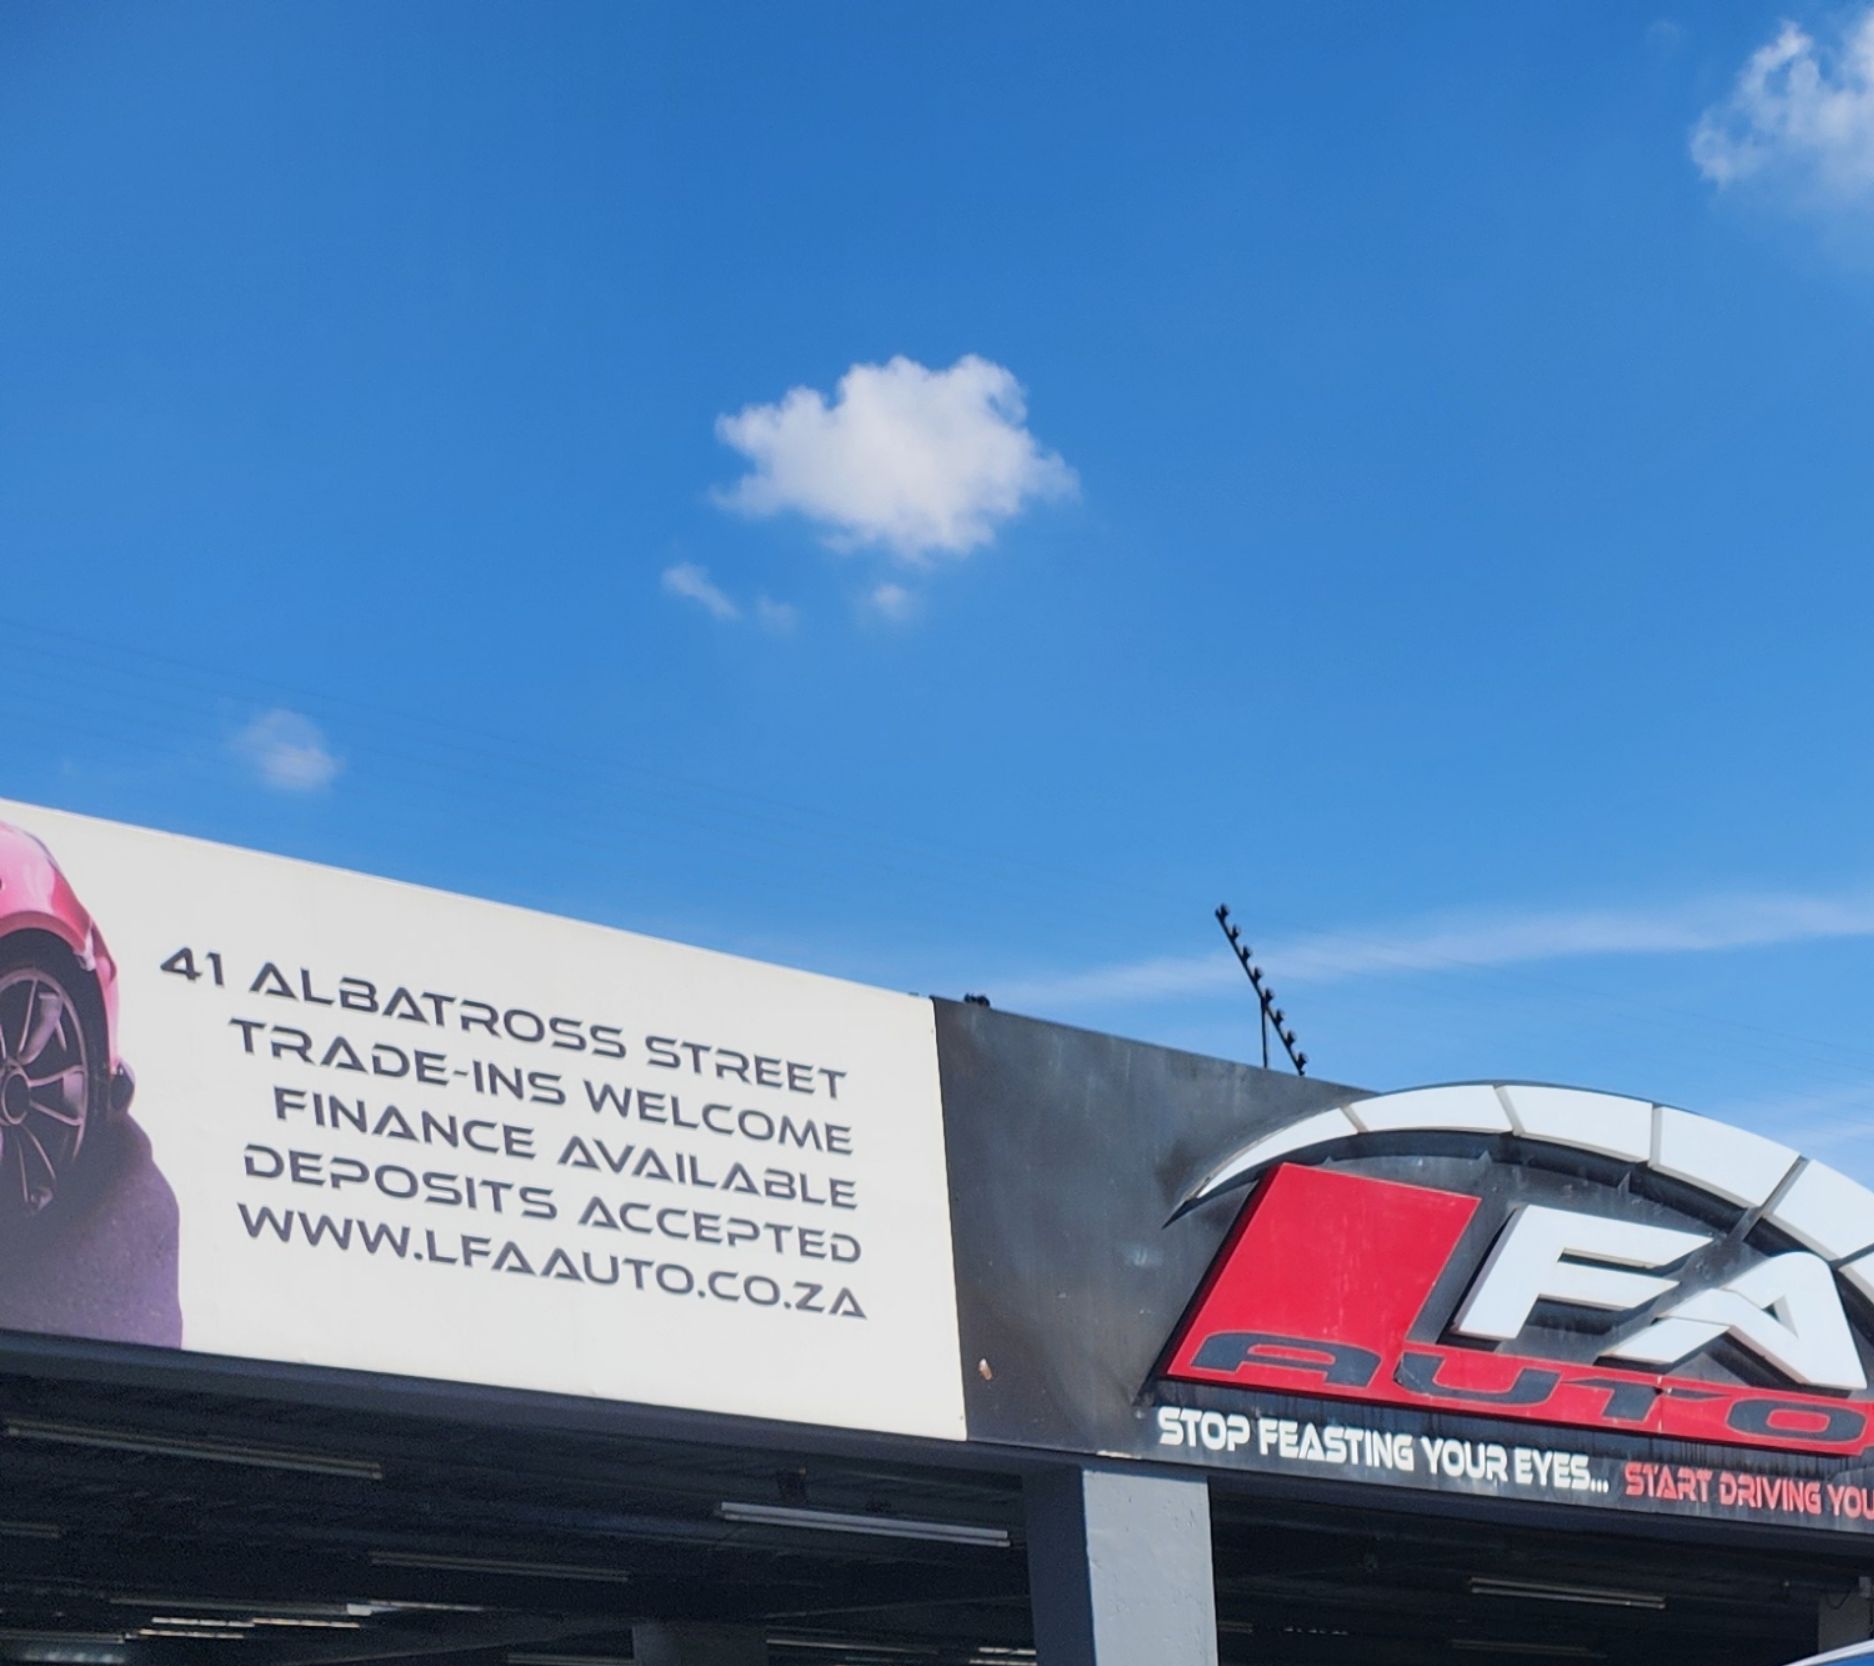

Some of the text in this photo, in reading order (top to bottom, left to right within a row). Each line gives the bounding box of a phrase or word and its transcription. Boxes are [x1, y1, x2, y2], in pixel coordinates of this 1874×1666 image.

[160, 946, 848, 1100] 41 ALBATROSS STREET
[228, 1017, 854, 1156] TRADE-INS WELCOME
[243, 1143, 862, 1264] DEPOSITS ACCEPTED
[273, 1085, 858, 1211] FINANCE AVAILABLE
[236, 1201, 868, 1320] WWW.LFAAUTO.CO.ZA
[1167, 1161, 1868, 1392] LFA
[1190, 1330, 1868, 1443] AUTO
[1157, 1405, 1610, 1494] STOP FEASTING YOUR EYES...
[1623, 1460, 1714, 1503] START
[1718, 1469, 1822, 1517] DRIVING
